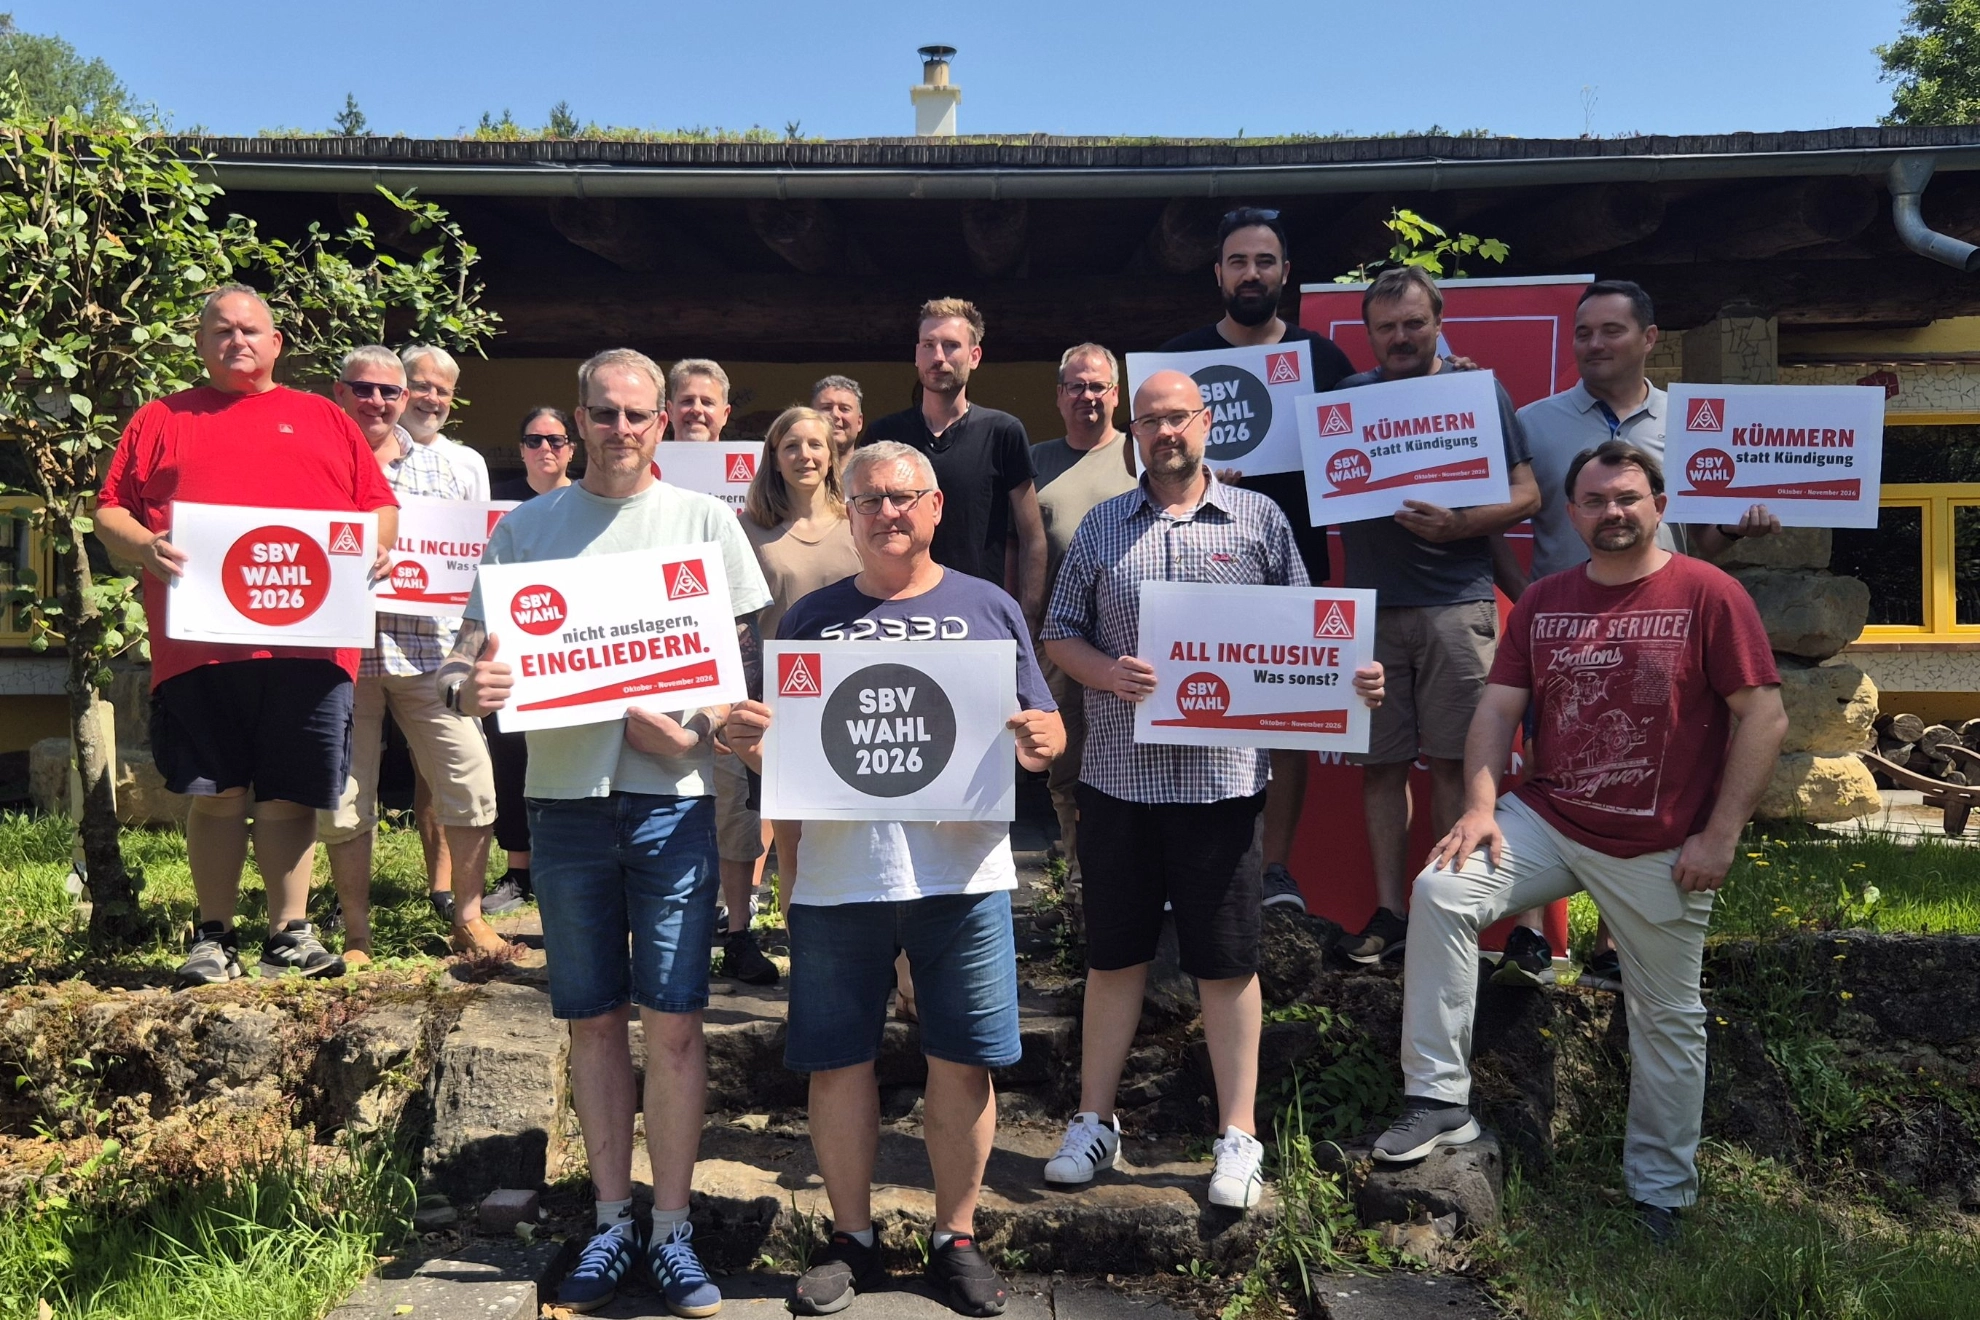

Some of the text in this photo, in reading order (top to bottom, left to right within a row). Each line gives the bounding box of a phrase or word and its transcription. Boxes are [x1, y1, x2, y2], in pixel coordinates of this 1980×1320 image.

[1198, 379, 1240, 403] SBV
[1205, 400, 1255, 423] AHL
[1362, 411, 1476, 443] KÜMMERN
[1732, 423, 1855, 448] KÜMMERN
[1370, 436, 1479, 458] statt Kündigung
[1333, 455, 1360, 470] SBV
[1696, 457, 1724, 469] SBV
[1736, 451, 1854, 468] statt Kündigung
[1329, 466, 1368, 483] WAHL
[1690, 469, 1730, 481] WAHL
[252, 542, 300, 563] SBV
[398, 567, 421, 578] SBV
[447, 560, 470, 571] Was
[240, 566, 312, 586] WAHL
[392, 577, 426, 589] WAHL
[248, 588, 305, 609] 2026
[519, 592, 552, 609] SBV
[514, 606, 564, 625] WAHL
[562, 615, 699, 644] nicht auslagern,
[1536, 615, 1685, 639] REPAIR SERVICE
[521, 631, 711, 677] EINGLIEDERN.
[1169, 641, 1340, 667] ALL INCLUSIVE
[623, 684, 653, 694] Oktober
[658, 677, 694, 689] November
[695, 674, 714, 684] 2026
[1253, 669, 1339, 687] Was sonst?
[1187, 682, 1218, 695] SBV
[858, 687, 916, 714] SBV
[1180, 697, 1225, 711] WAHL
[846, 717, 932, 745] WAHL
[1291, 720, 1324, 728] November
[856, 747, 924, 775] 2026
